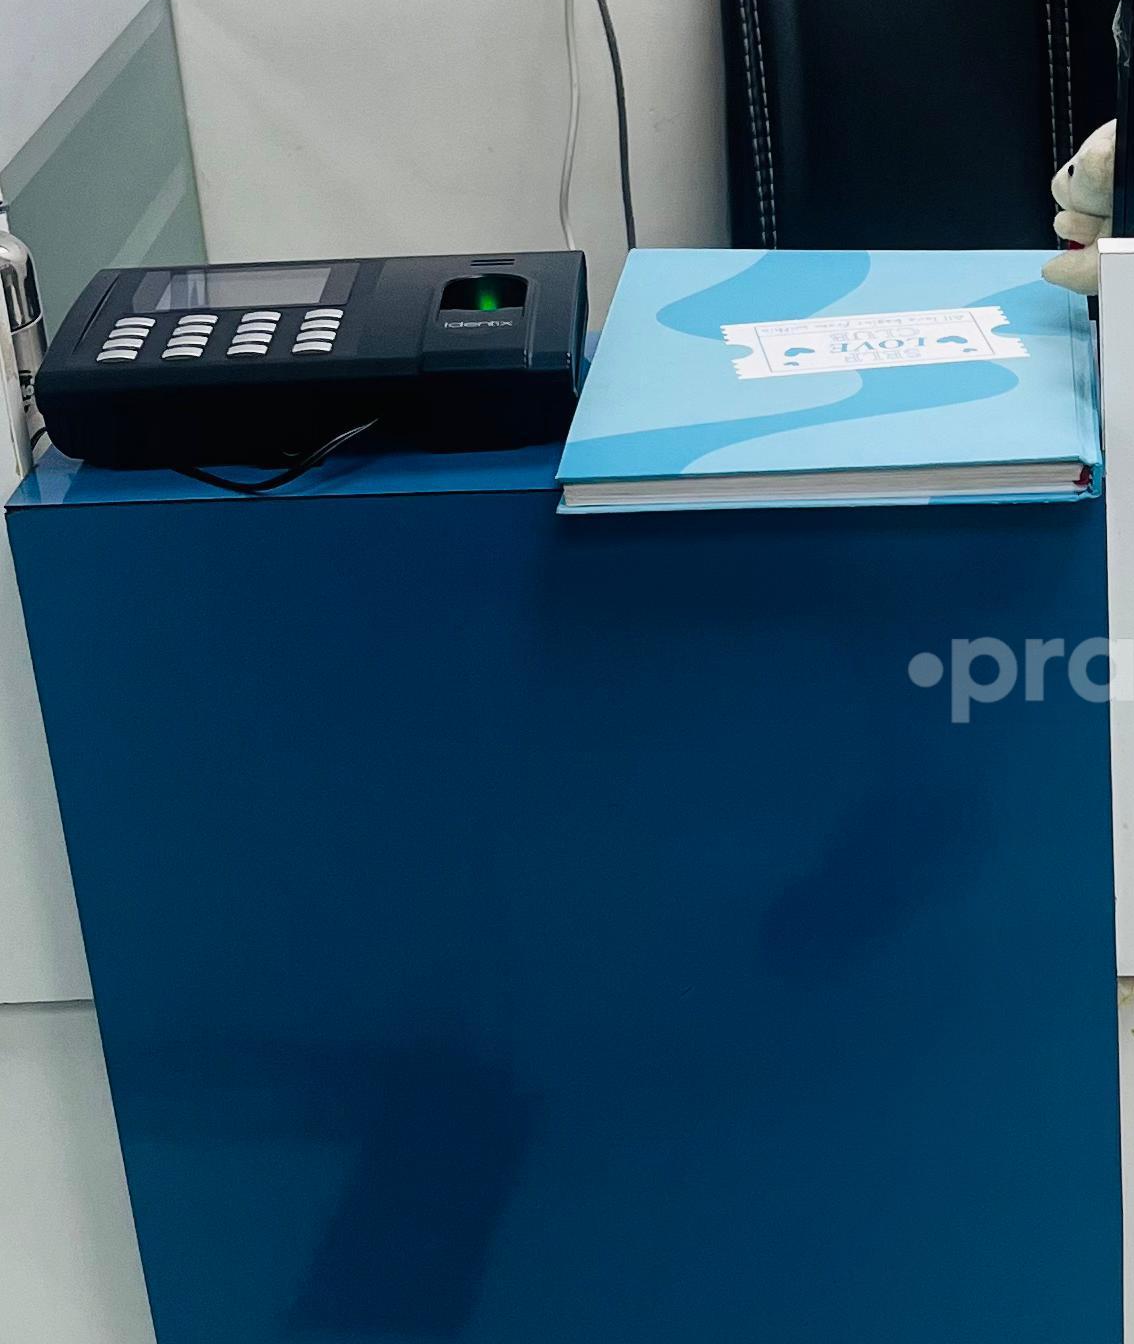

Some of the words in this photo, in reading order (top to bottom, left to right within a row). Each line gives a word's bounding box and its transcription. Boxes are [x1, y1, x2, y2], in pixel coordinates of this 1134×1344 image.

[829, 327, 921, 342] CLUB
[829, 337, 925, 353] LOVE
[843, 348, 922, 363] SELF
